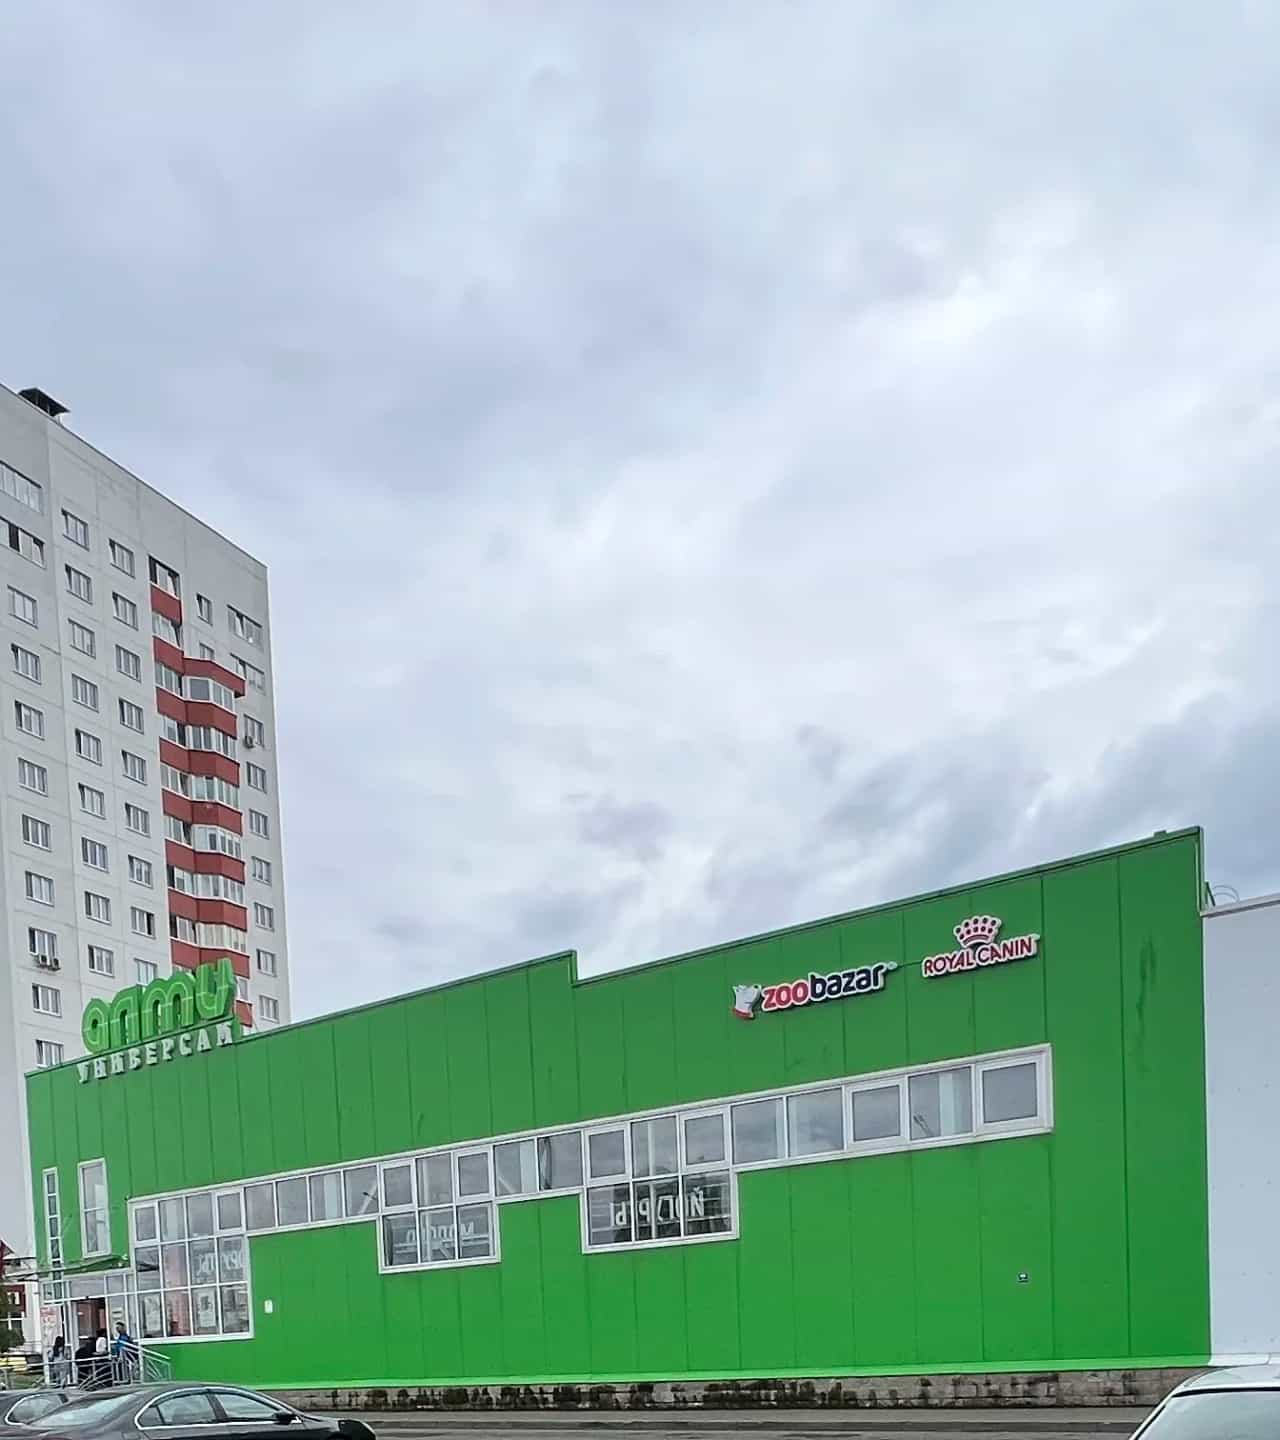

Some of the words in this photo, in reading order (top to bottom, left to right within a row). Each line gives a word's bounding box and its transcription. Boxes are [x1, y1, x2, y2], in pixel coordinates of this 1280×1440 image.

[923, 950, 975, 976] ROYAL
[976, 936, 1034, 964] CANIN
[762, 963, 886, 1010] zoobazar
[76, 1021, 234, 1083] УНИВЕРСАМ
